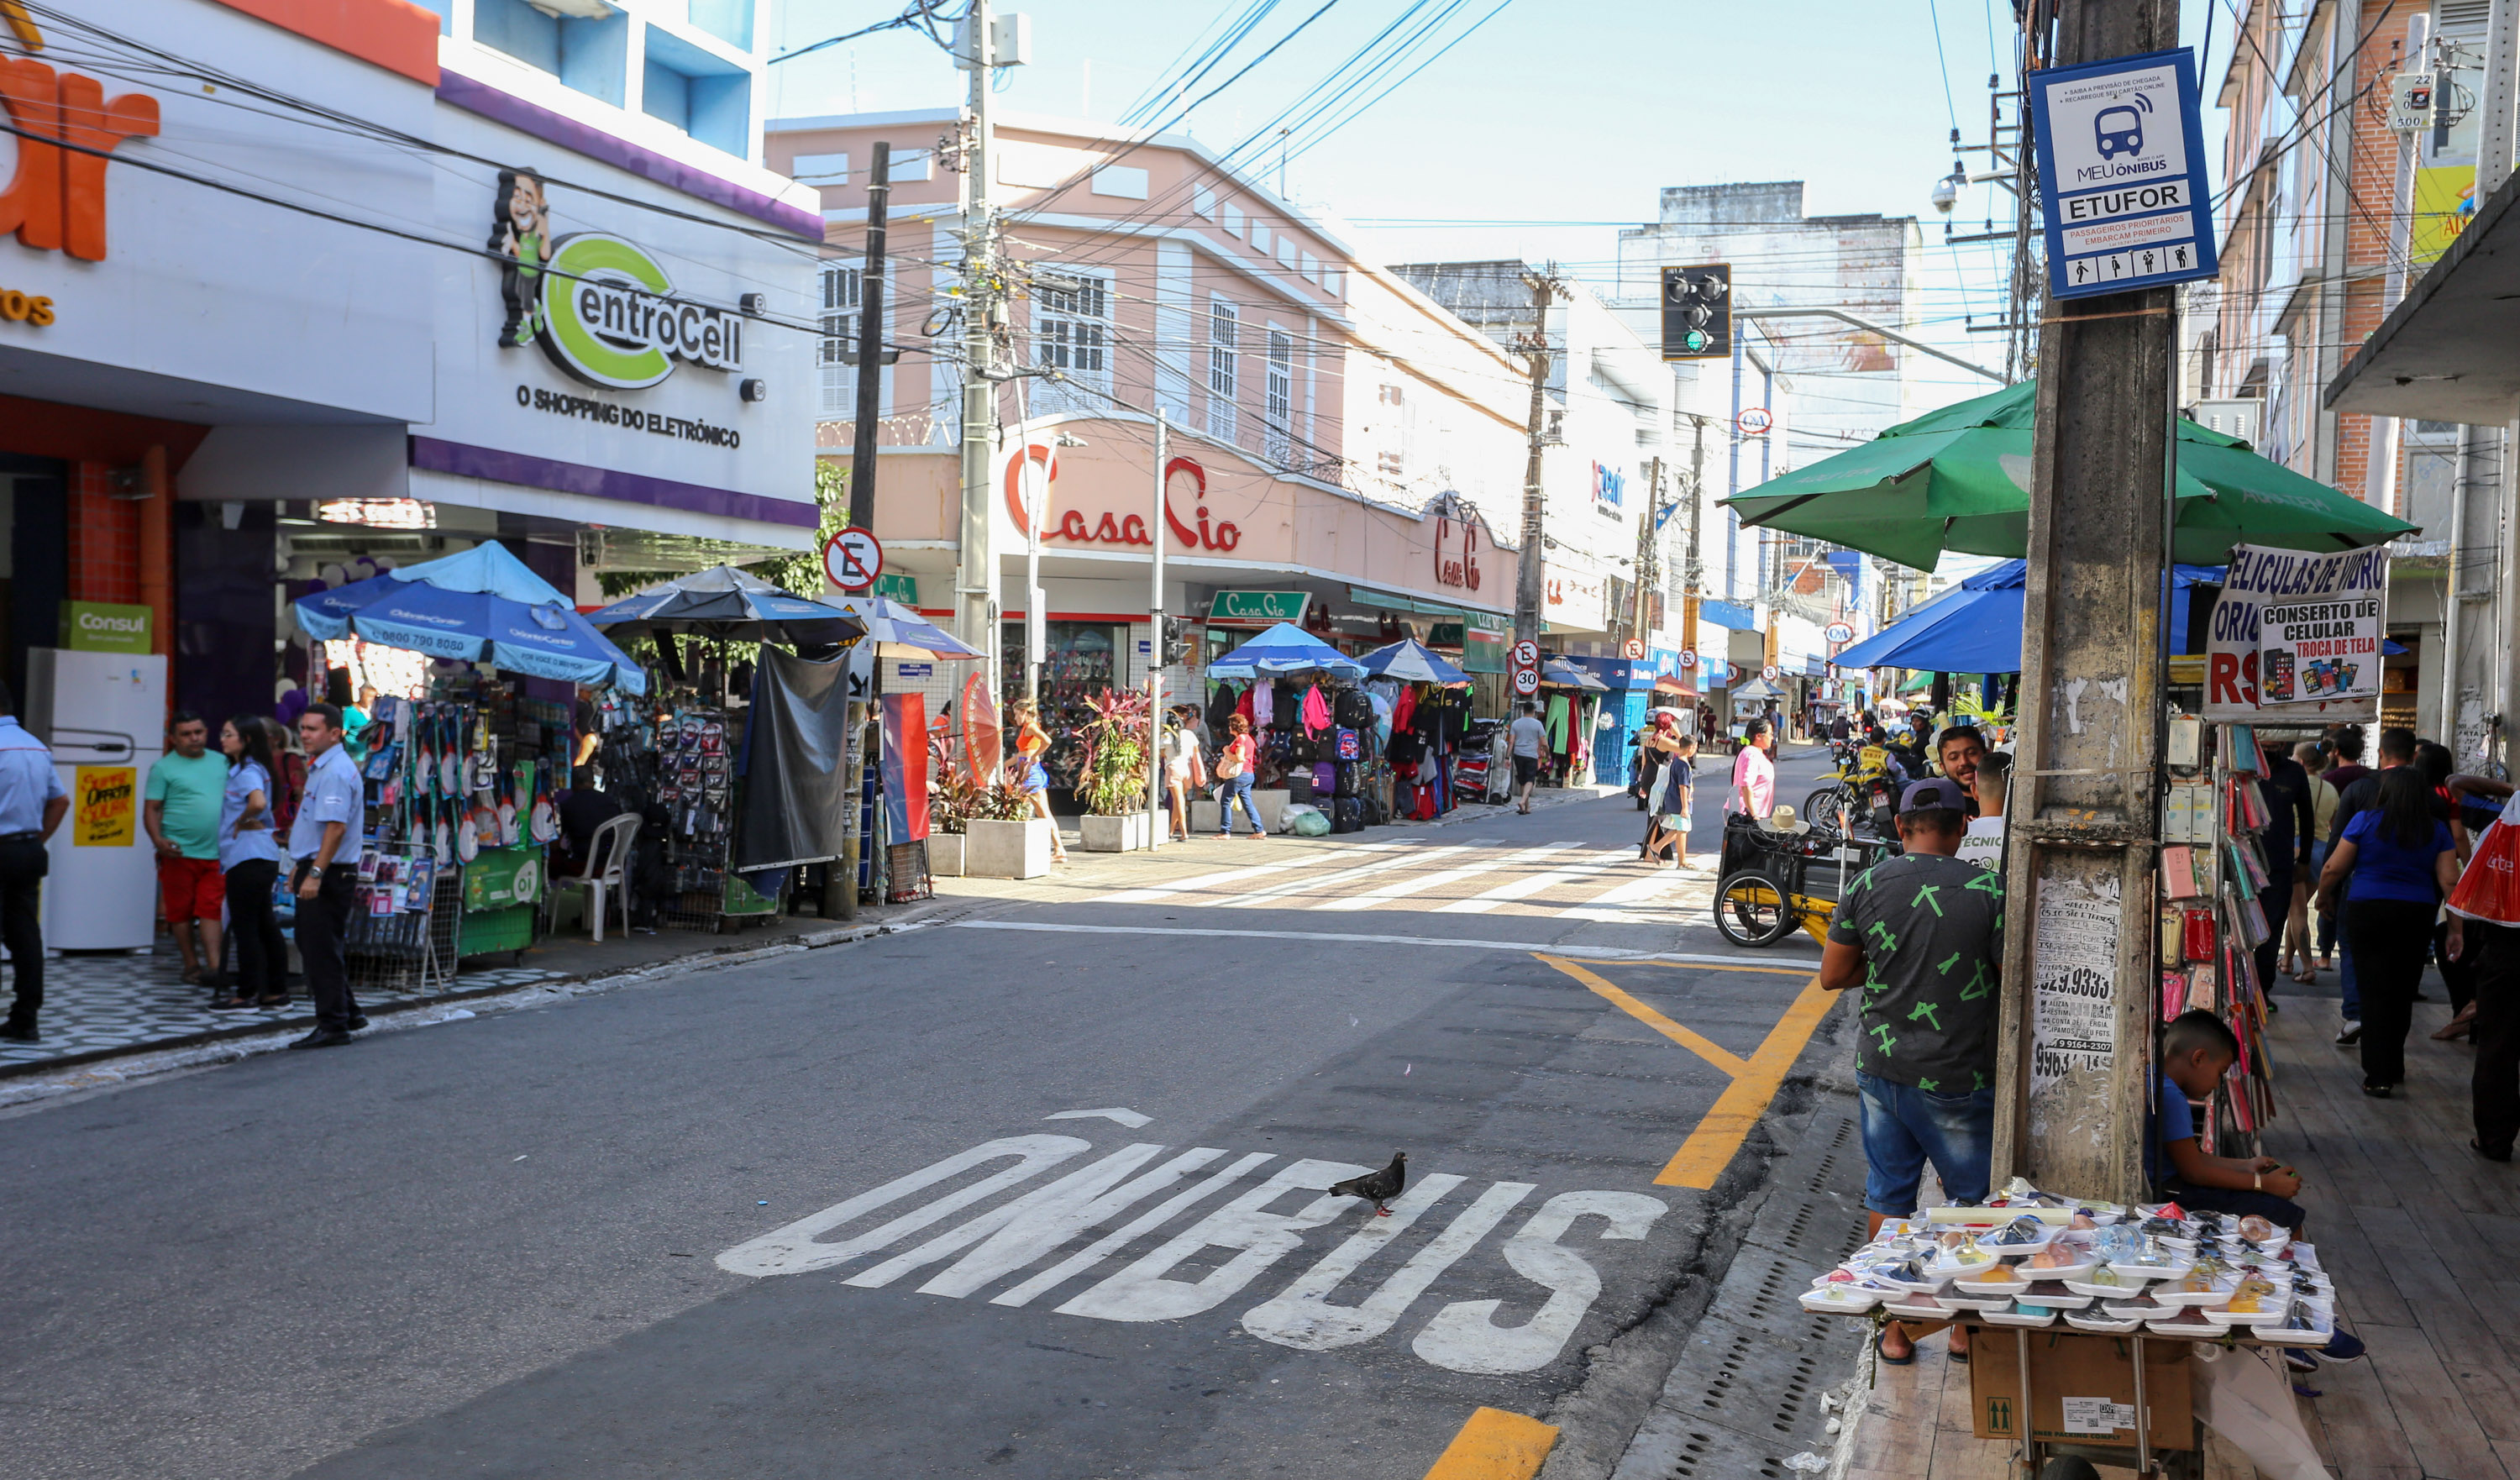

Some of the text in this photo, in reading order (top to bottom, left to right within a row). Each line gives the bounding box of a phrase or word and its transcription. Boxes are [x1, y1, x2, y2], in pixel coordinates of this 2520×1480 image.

[2093, 81, 2122, 91] PREVISÃO
[2132, 76, 2160, 85] CHEGADA
[2415, 76, 2430, 84] 22
[2065, 92, 2104, 103] RECARREGUE
[2118, 86, 2143, 94] CARTÃO
[2144, 82, 2166, 91] ONLINE
[2397, 118, 2420, 127] 500
[2077, 160, 2167, 182] MEU ÔNIBUS
[2069, 185, 2180, 219] ETUFOR
[2070, 215, 2185, 239] PASSAGEIROS PRIORITÁRIOS
[2085, 226, 2172, 245] EMBARCAM PRIMEIRO
[517, 386, 740, 449] O SHOPPING DO ELETRÔNICO
[1005, 443, 1153, 547] Casa
[843, 543, 864, 578] E
[2313, 557, 2342, 593] DE
[1226, 593, 1263, 617] Casa
[2264, 601, 2377, 625] CONSERTO DE
[79, 612, 144, 632] Consul
[2284, 621, 2355, 642] CELULAR
[382, 631, 464, 652] 0800 790 8080
[2296, 637, 2376, 659] TROCA DE TELA
[1518, 673, 1536, 685] 30
[517, 872, 533, 895] oi
[2066, 1041, 2112, 1051] 9164-2307
[714, 1106, 1668, 1375] ÔNIBUS
[2090, 1432, 2121, 1441] COMPLY
